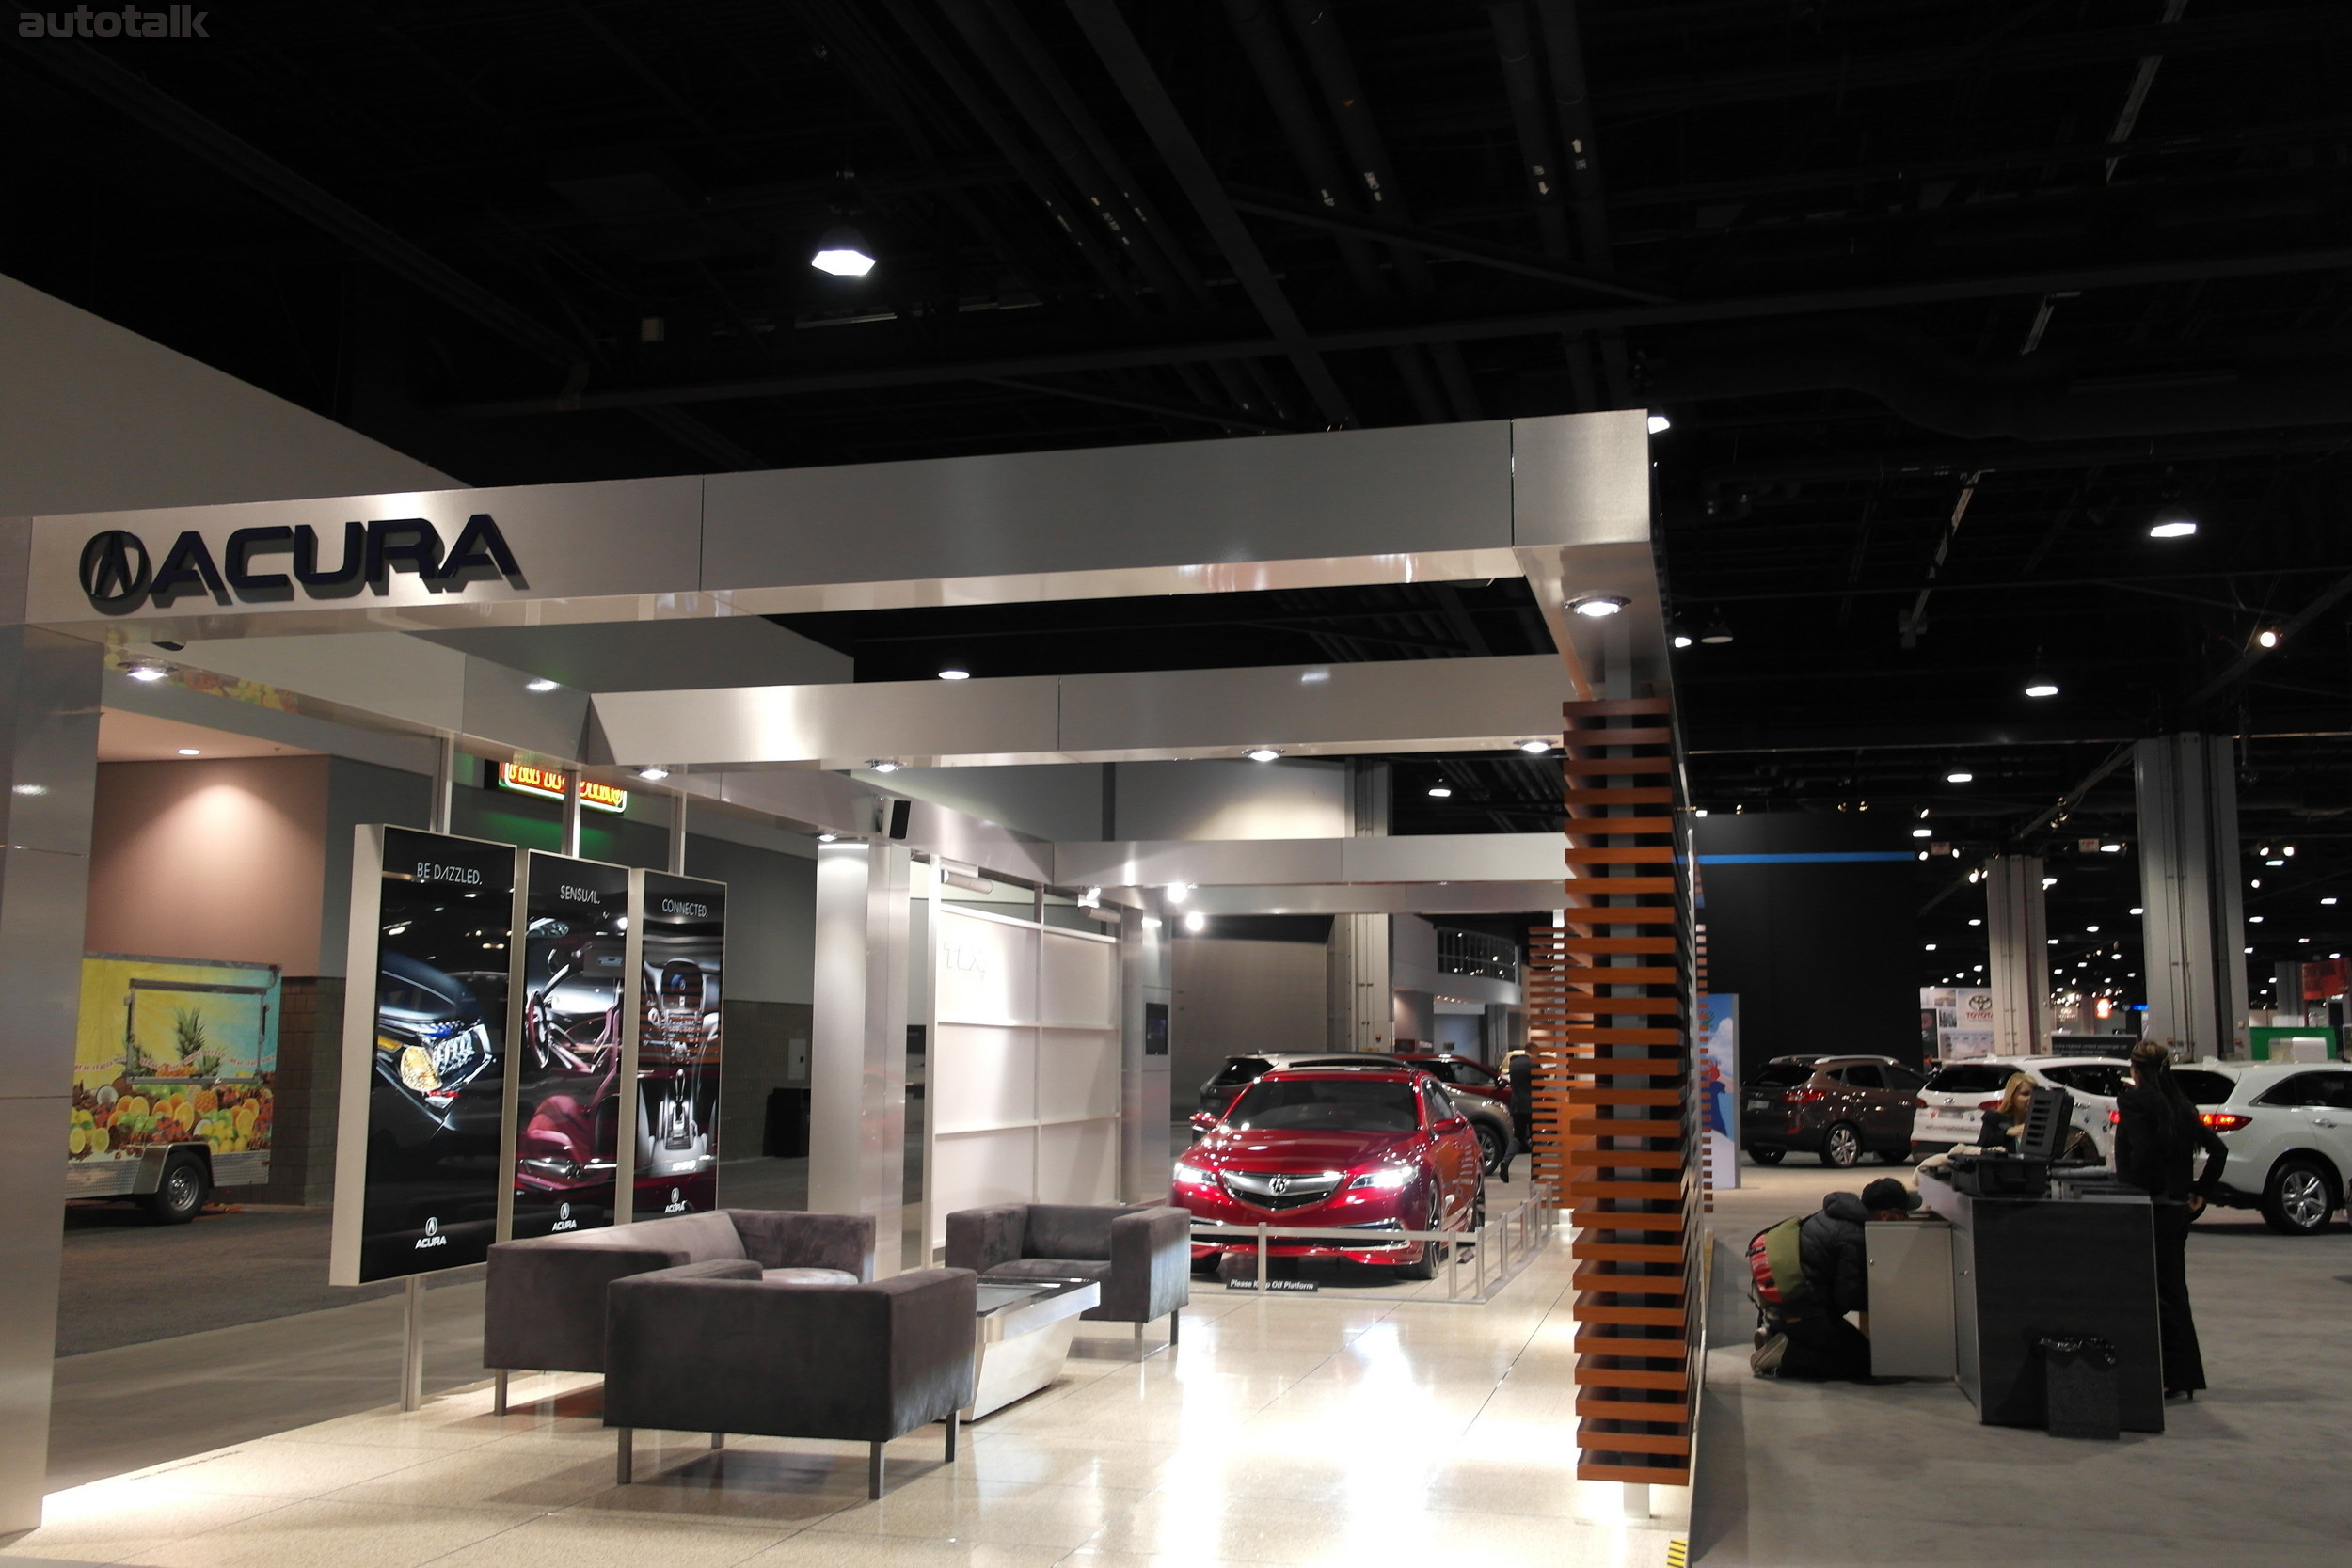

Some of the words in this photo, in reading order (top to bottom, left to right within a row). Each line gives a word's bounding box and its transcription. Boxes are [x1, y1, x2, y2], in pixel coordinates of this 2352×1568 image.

[149, 514, 527, 598] ACURA
[417, 862, 431, 878] BE
[434, 864, 483, 885] DAZZLED.
[560, 884, 601, 904] SENSUAL.
[662, 898, 708, 918] CONNECTED.
[551, 1219, 577, 1232] ACURA
[415, 1235, 448, 1250] ACURA
[1230, 1279, 1252, 1288] Please
[1253, 1280, 1270, 1290] Kp
[1271, 1280, 1283, 1289] Off
[1283, 1280, 1314, 1290] Platform
